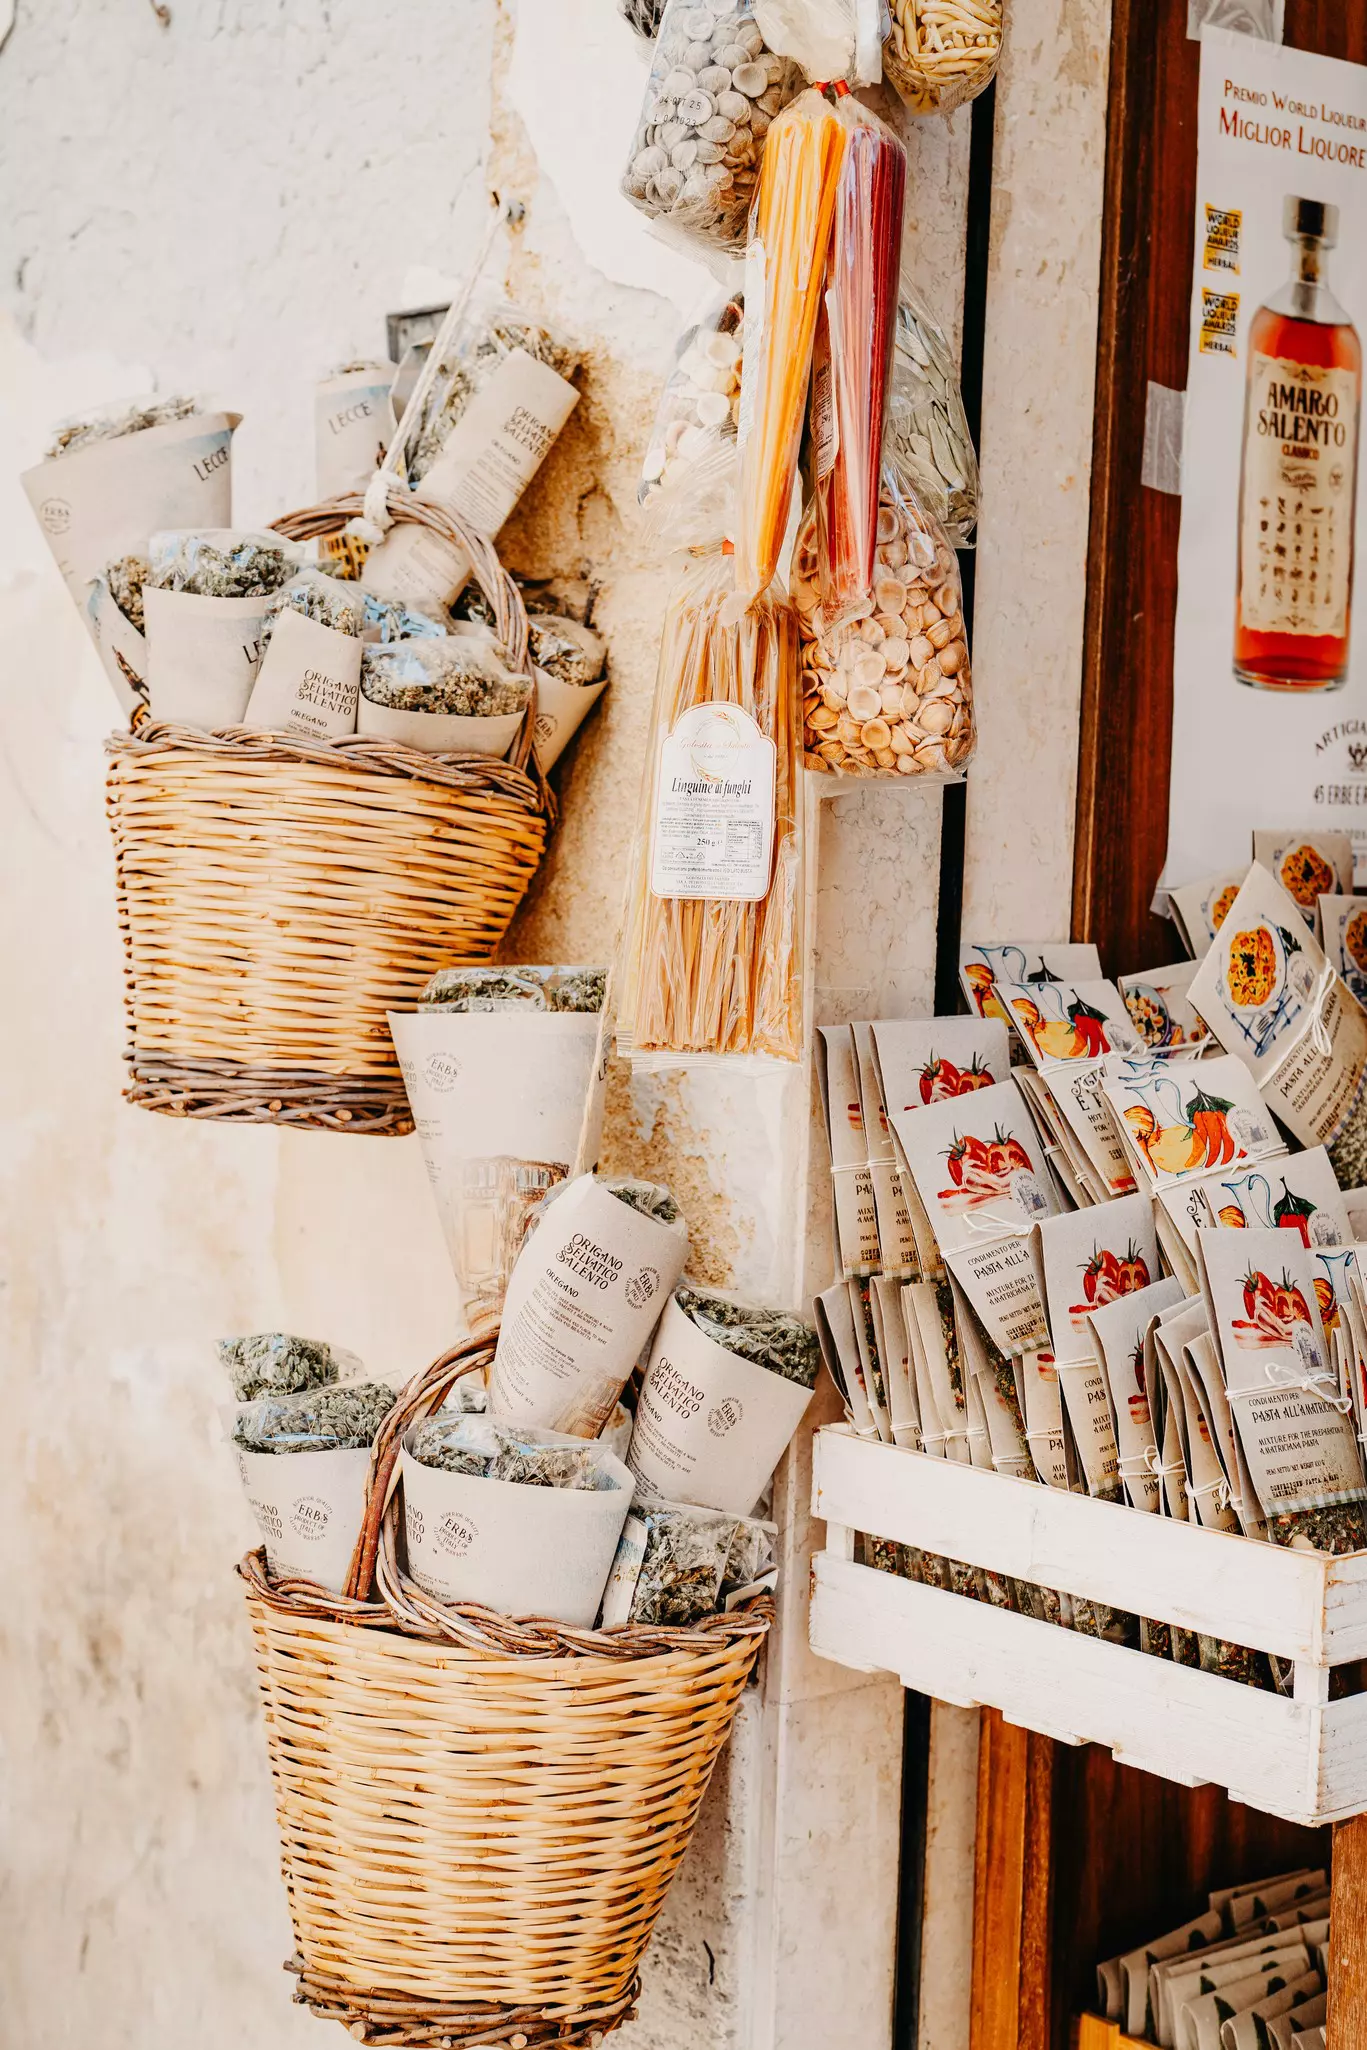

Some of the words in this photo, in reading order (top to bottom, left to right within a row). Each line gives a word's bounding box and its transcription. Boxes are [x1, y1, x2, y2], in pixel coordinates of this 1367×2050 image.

[689, 100, 701, 111] 25
[1219, 106, 1292, 150] MIGLIOR
[1297, 125, 1366, 168] LIQUORE
[1207, 212, 1240, 229] WORLD
[1204, 295, 1238, 312] WORLD
[1267, 381, 1338, 418] AMARO
[327, 400, 373, 436] LECCE
[1257, 408, 1346, 447] SALENTO
[192, 445, 230, 482] LECCE
[299, 679, 357, 706] SELVATICO
[304, 668, 358, 695] ORIGANO
[295, 688, 352, 716] SALENTO
[290, 709, 328, 728] OREGANO
[671, 777, 713, 797] Linguine
[721, 779, 752, 798] funghi
[431, 1059, 458, 1078] ERBS
[1280, 1066, 1304, 1098] PASTA
[1303, 1045, 1318, 1068] ALL
[1088, 1113, 1102, 1123] HOT
[1094, 1124, 1108, 1132] FOR
[563, 1241, 619, 1282] SELVATICO
[572, 1233, 624, 1271] ORIGANO
[967, 1245, 1009, 1267] CONDIMENTO
[1008, 1240, 1022, 1250] PER
[555, 1249, 609, 1290] SALENTO
[973, 1260, 1004, 1280] PASTA
[546, 1268, 580, 1298] OREGANO
[639, 1272, 655, 1299] ERBS
[985, 1282, 1014, 1298] MIXTURE
[1014, 1277, 1027, 1288] FOR
[652, 1366, 700, 1413] SELVATICO
[659, 1357, 705, 1402] ORIGANO
[649, 1375, 691, 1420] SALENTO
[1248, 1394, 1289, 1407] CONDIMENTO
[1289, 1392, 1300, 1401] PER
[721, 1402, 738, 1427] ERBS
[1251, 1408, 1281, 1424] PASTA
[1258, 1433, 1287, 1446] MIXTURE
[1287, 1432, 1300, 1441] FOR
[1300, 1430, 1312, 1440] THE
[1259, 1443, 1302, 1456] AMATRICIANA
[1302, 1438, 1320, 1448] PASTA
[1052, 1472, 1067, 1481] AM
[298, 1504, 329, 1524] ERBS
[445, 1518, 474, 1544] ERBS
